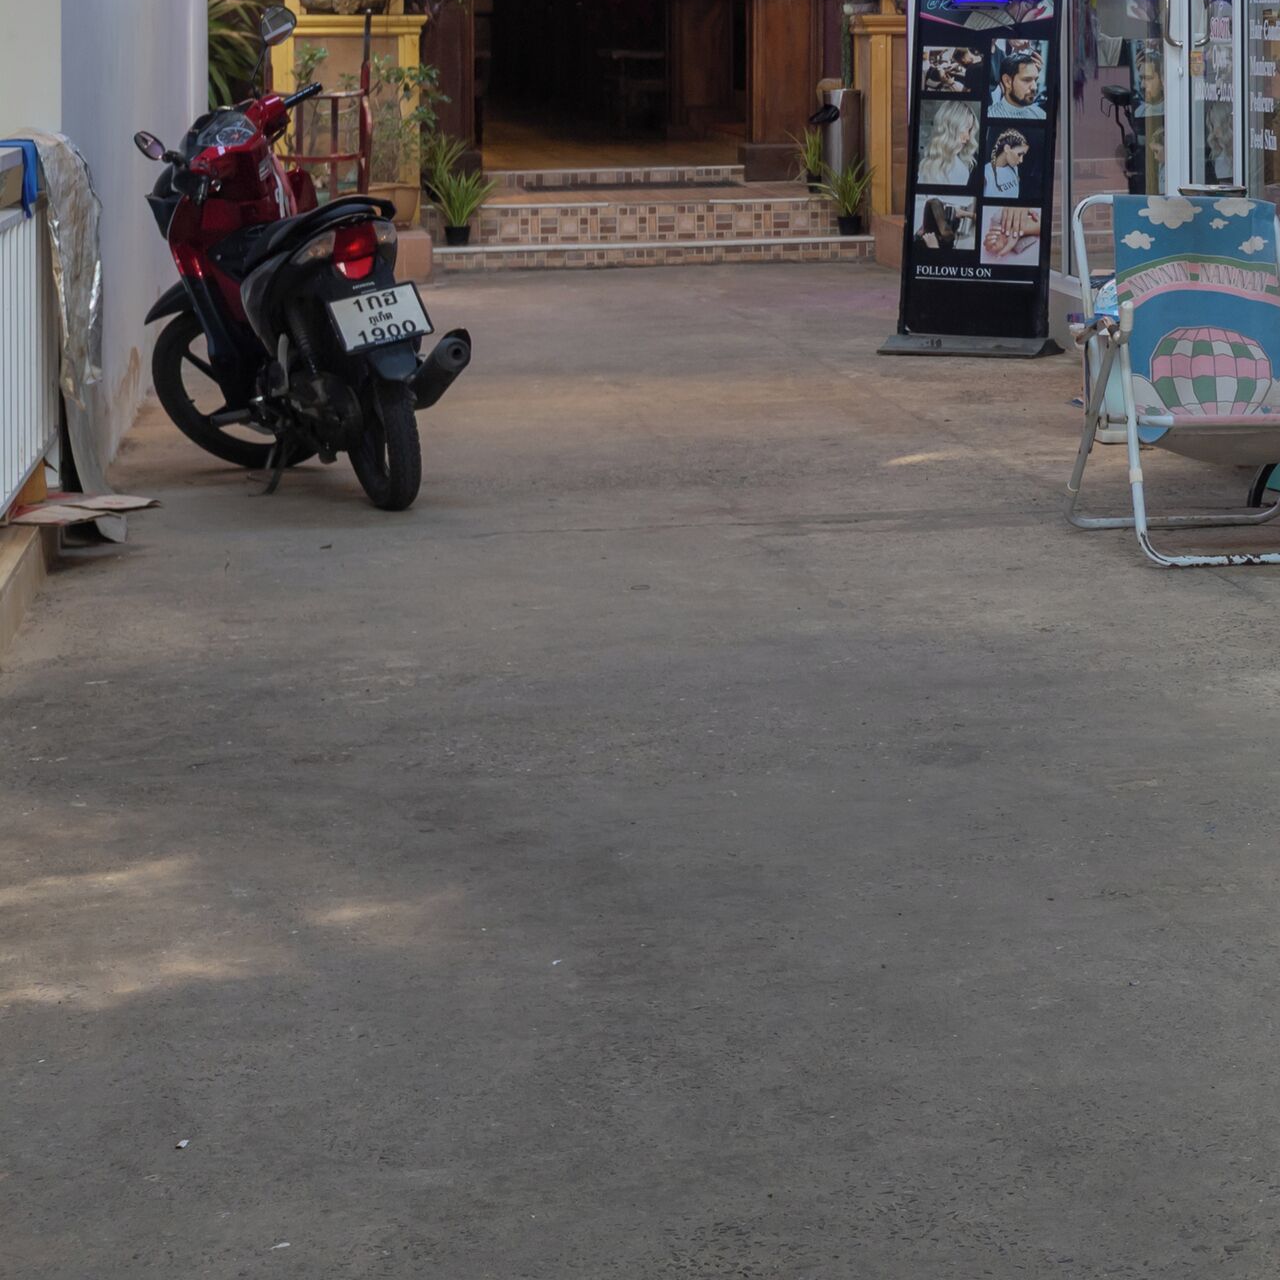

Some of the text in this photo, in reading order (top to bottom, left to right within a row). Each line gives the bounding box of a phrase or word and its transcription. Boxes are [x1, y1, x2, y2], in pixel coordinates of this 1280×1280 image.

[916, 265, 992, 279] FOLLOW US ON
[358, 320, 417, 345] 1900
